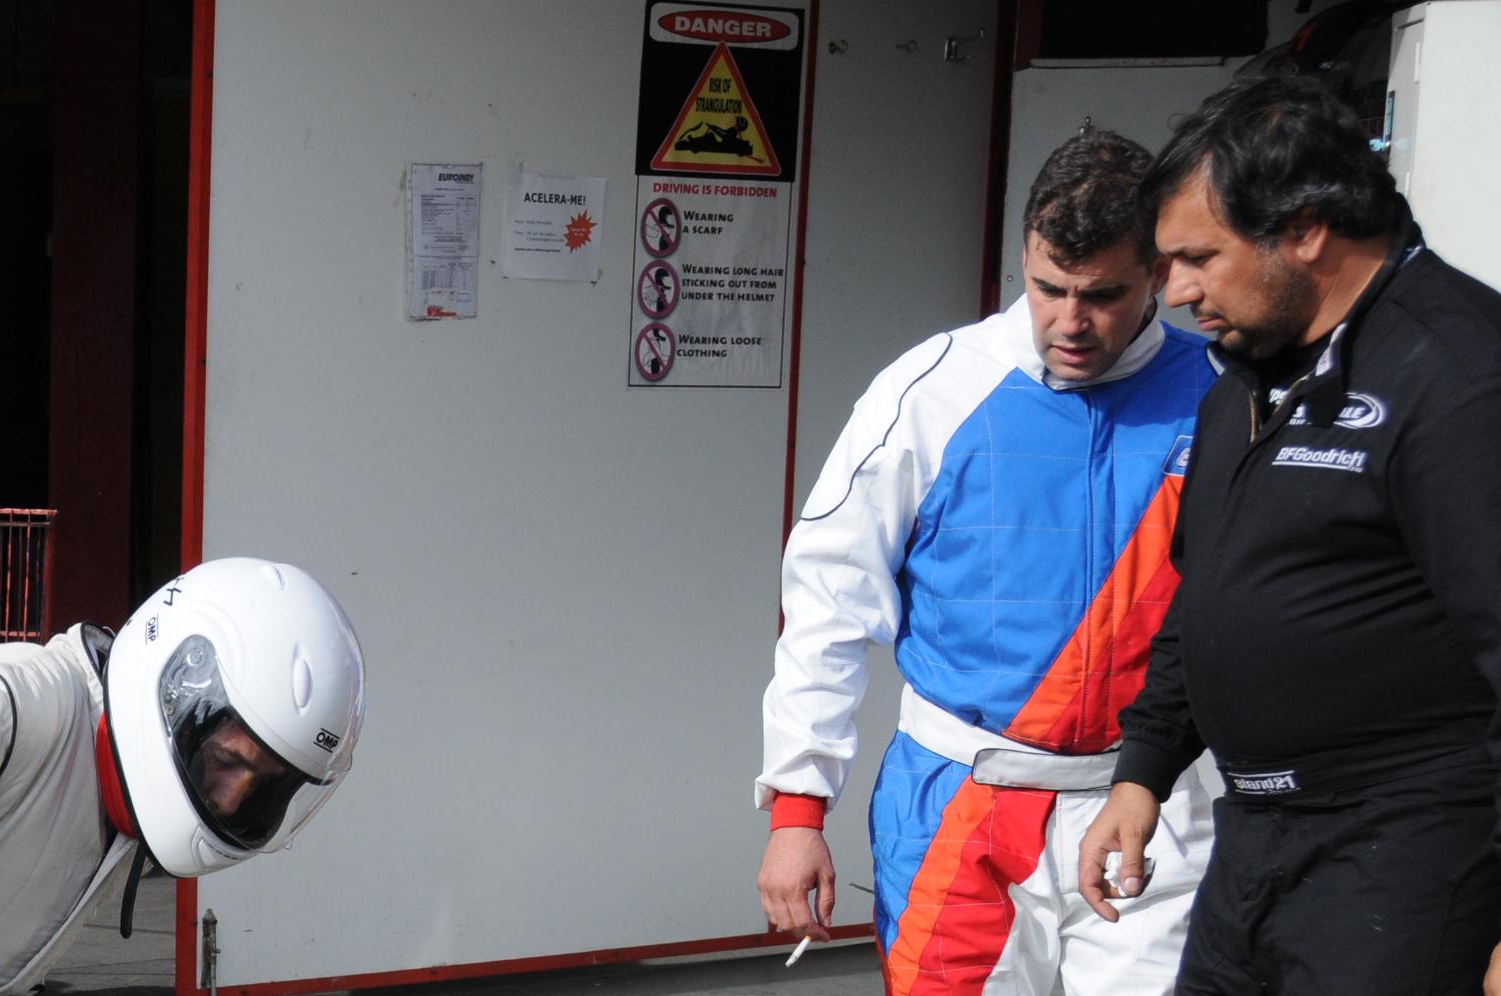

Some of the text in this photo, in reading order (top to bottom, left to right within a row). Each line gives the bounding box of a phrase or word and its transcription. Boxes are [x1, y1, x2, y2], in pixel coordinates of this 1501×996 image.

[674, 15, 772, 38] DANGER
[709, 78, 731, 93] RISK OF
[695, 96, 742, 114] STRANGULATION
[653, 183, 778, 198] DRIVING IS FORBIDDEN
[523, 192, 587, 206] ACELERA-ME!
[683, 211, 734, 222] WEARING
[682, 226, 724, 235] A SCARF
[682, 264, 784, 277] WEARING LONG HAIR
[681, 279, 777, 289] STICKING OUT FROM
[681, 292, 775, 302] UNDER THE HELMET
[678, 334, 762, 346] WEARING LOOSE
[676, 349, 728, 358] CLOTHING
[1275, 446, 1366, 468] BFGoodrich
[147, 616, 157, 642] OMP
[316, 731, 339, 750] OMP
